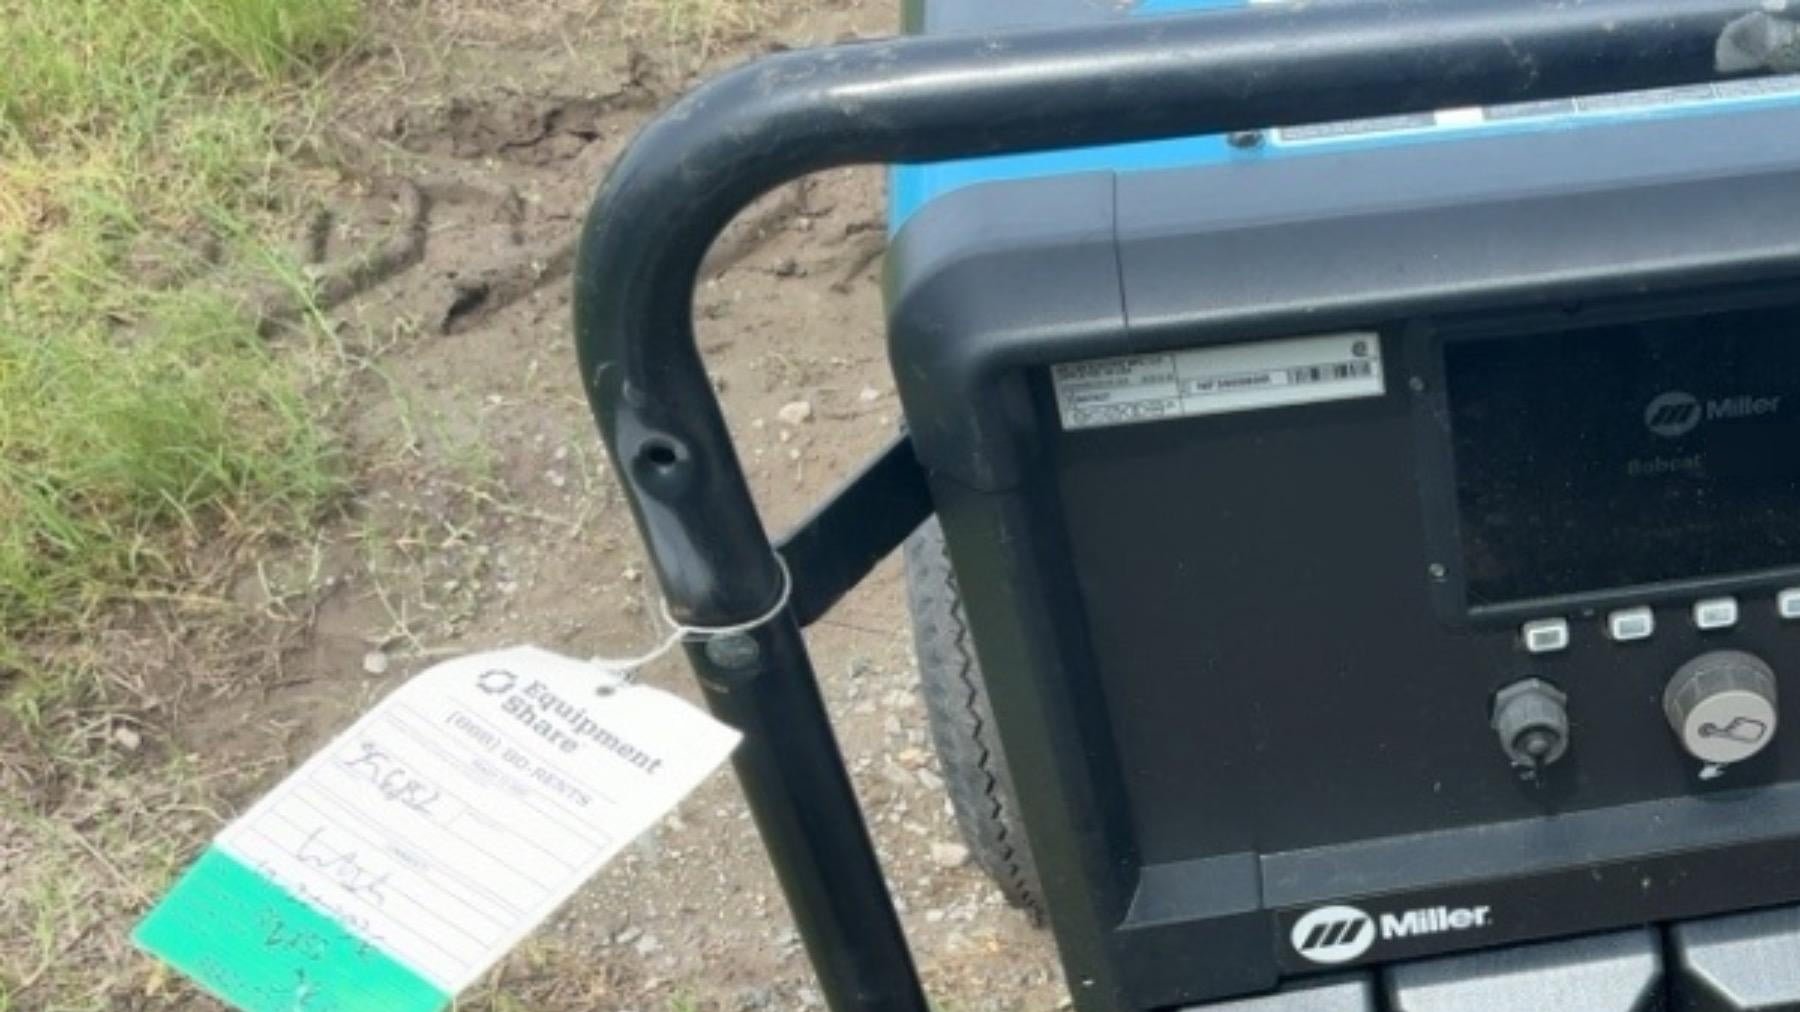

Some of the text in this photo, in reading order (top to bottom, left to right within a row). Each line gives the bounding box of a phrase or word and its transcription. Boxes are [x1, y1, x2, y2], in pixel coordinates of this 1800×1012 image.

[1706, 395, 1779, 420] Miller
[501, 695, 579, 753] Share
[523, 679, 662, 774] Equipment
[1379, 905, 1492, 940] Miller
